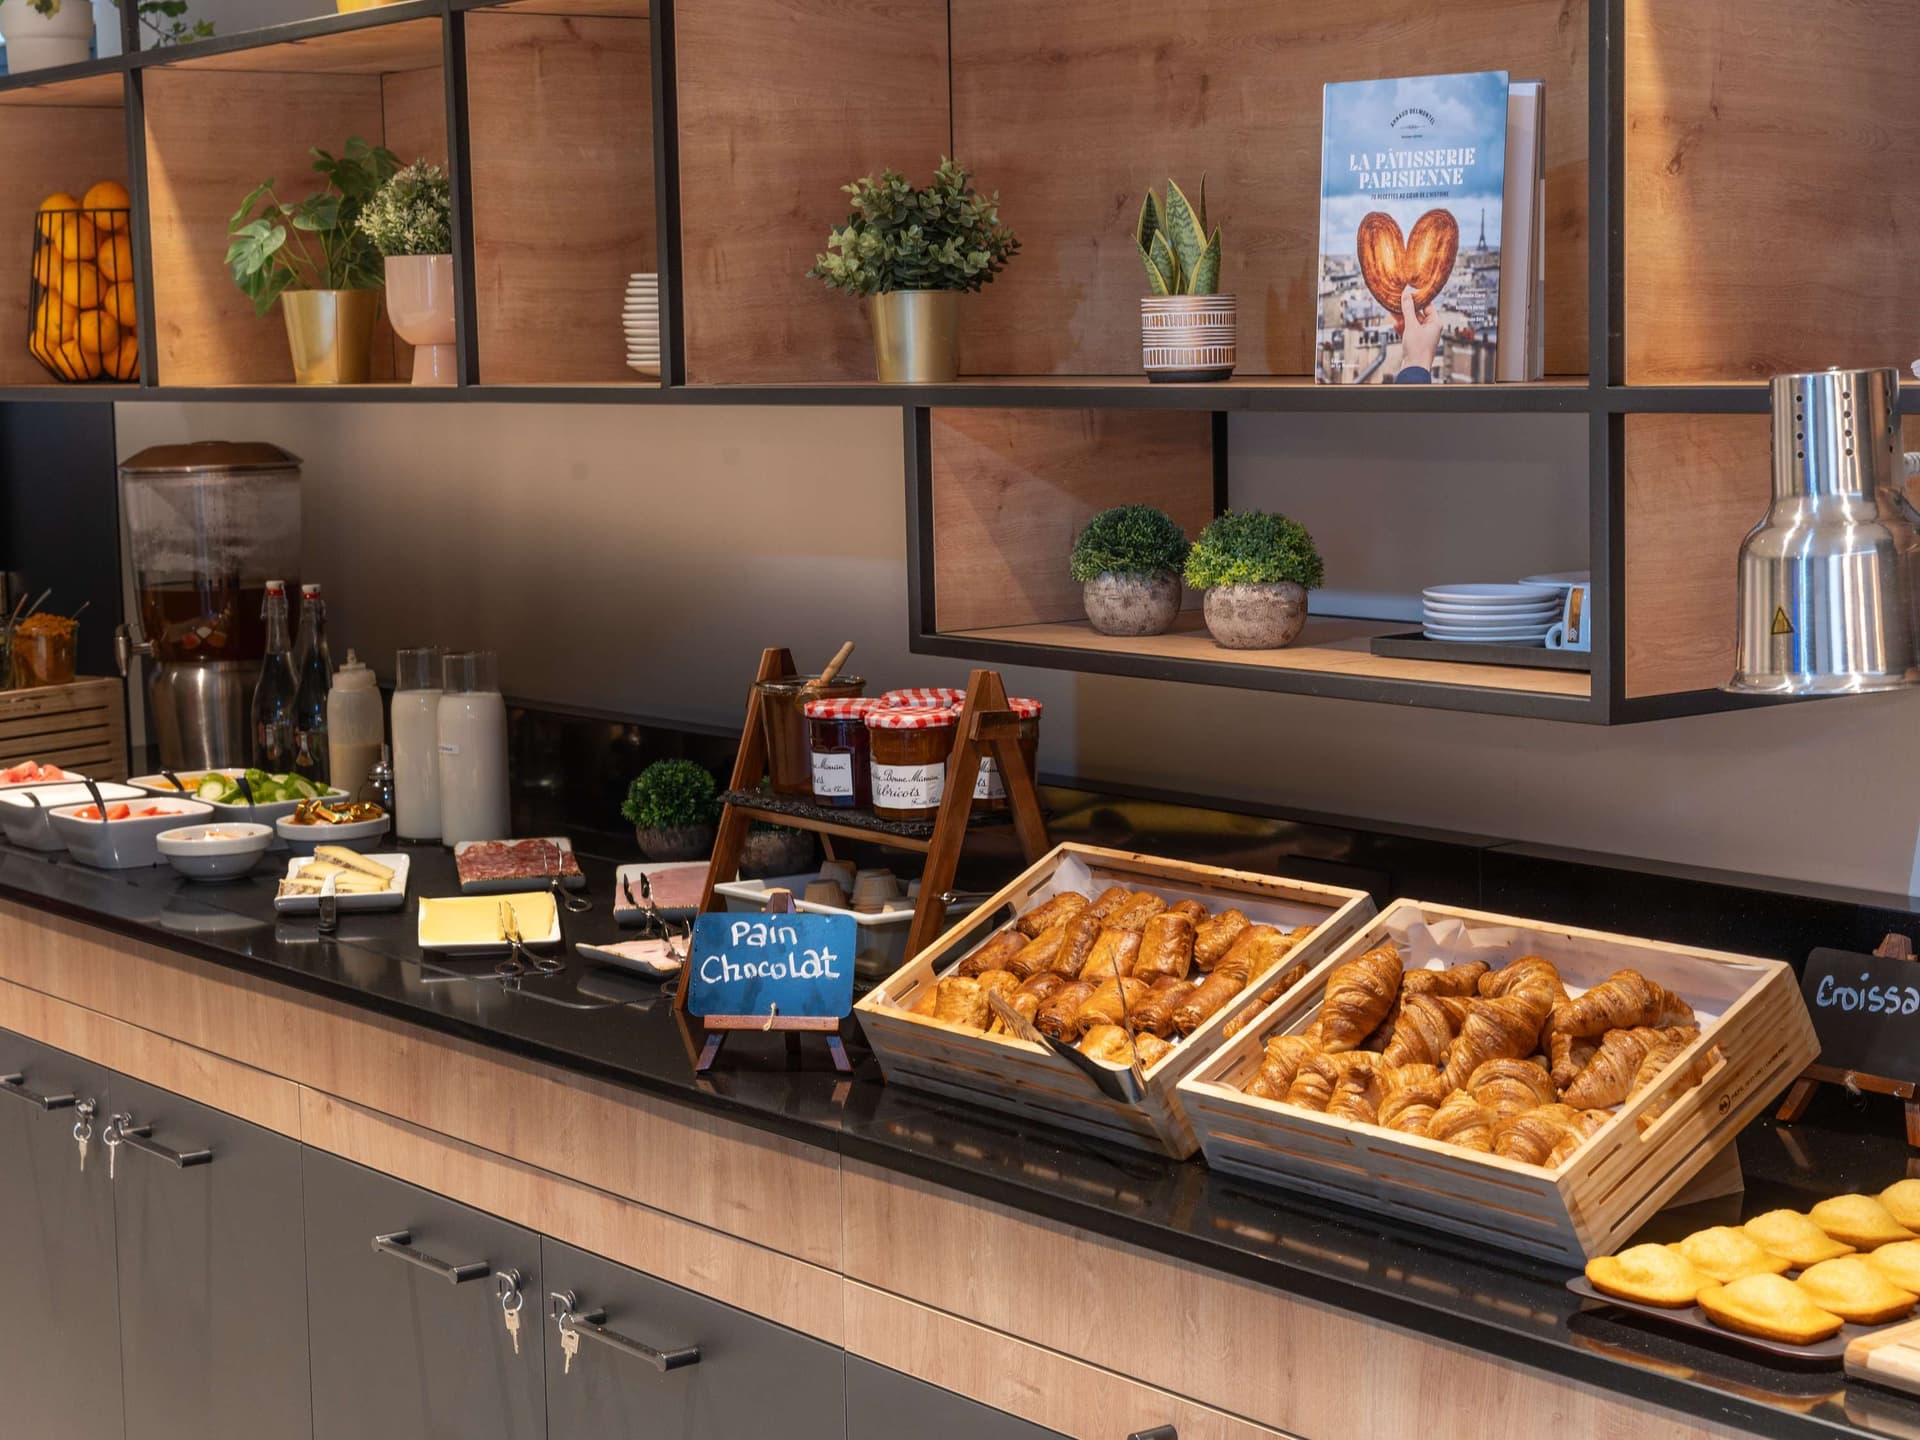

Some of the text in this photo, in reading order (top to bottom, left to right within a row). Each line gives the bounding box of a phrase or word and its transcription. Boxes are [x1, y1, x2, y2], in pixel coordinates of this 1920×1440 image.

[1349, 147, 1476, 171] LA PÂTISSERIE
[1359, 167, 1464, 190] PARISIENNE
[731, 915, 798, 948] Pain
[700, 946, 840, 984] Chocolat
